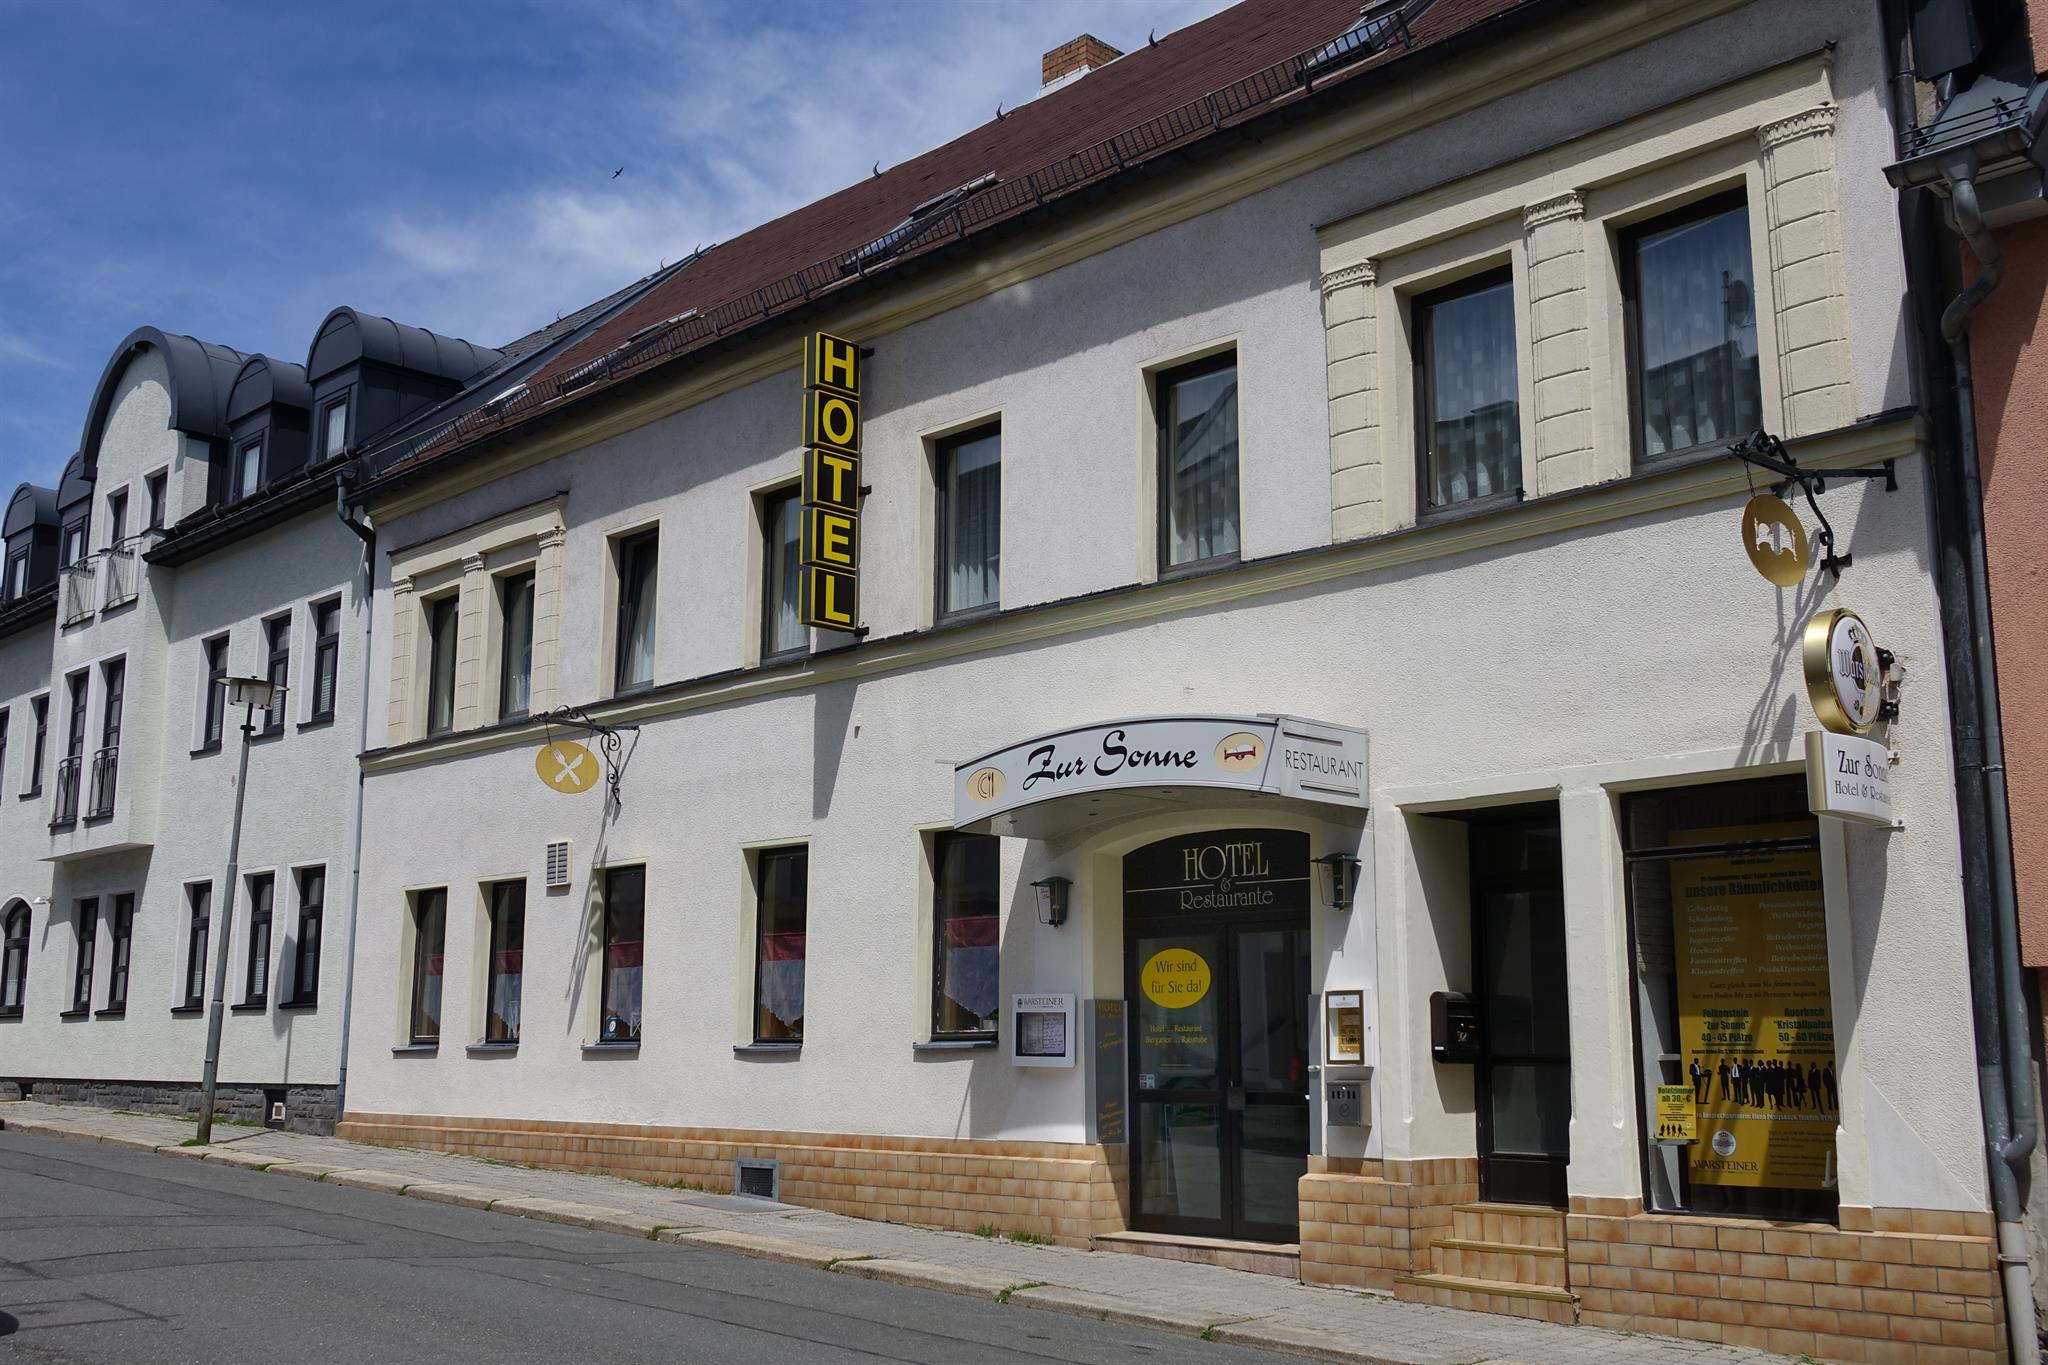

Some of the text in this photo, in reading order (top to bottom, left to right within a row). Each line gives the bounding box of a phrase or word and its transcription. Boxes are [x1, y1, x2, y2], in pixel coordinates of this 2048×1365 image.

[822, 338, 854, 624] HOTEL
[1022, 729, 1198, 791] Zur Sonne
[1285, 749, 1364, 780] RESTAURANT
[1837, 749, 1860, 776] Zur
[1834, 780, 1859, 797] Hotel
[1861, 784, 1869, 798] &
[1183, 842, 1269, 881] HOTEL
[1220, 876, 1231, 892] &
[1180, 888, 1273, 910] Restaurante
[1155, 958, 1196, 973] Wir sind
[1151, 980, 1165, 994] für
[1168, 980, 1183, 994] Sie
[1694, 1159, 1758, 1171] WARSTEINER
